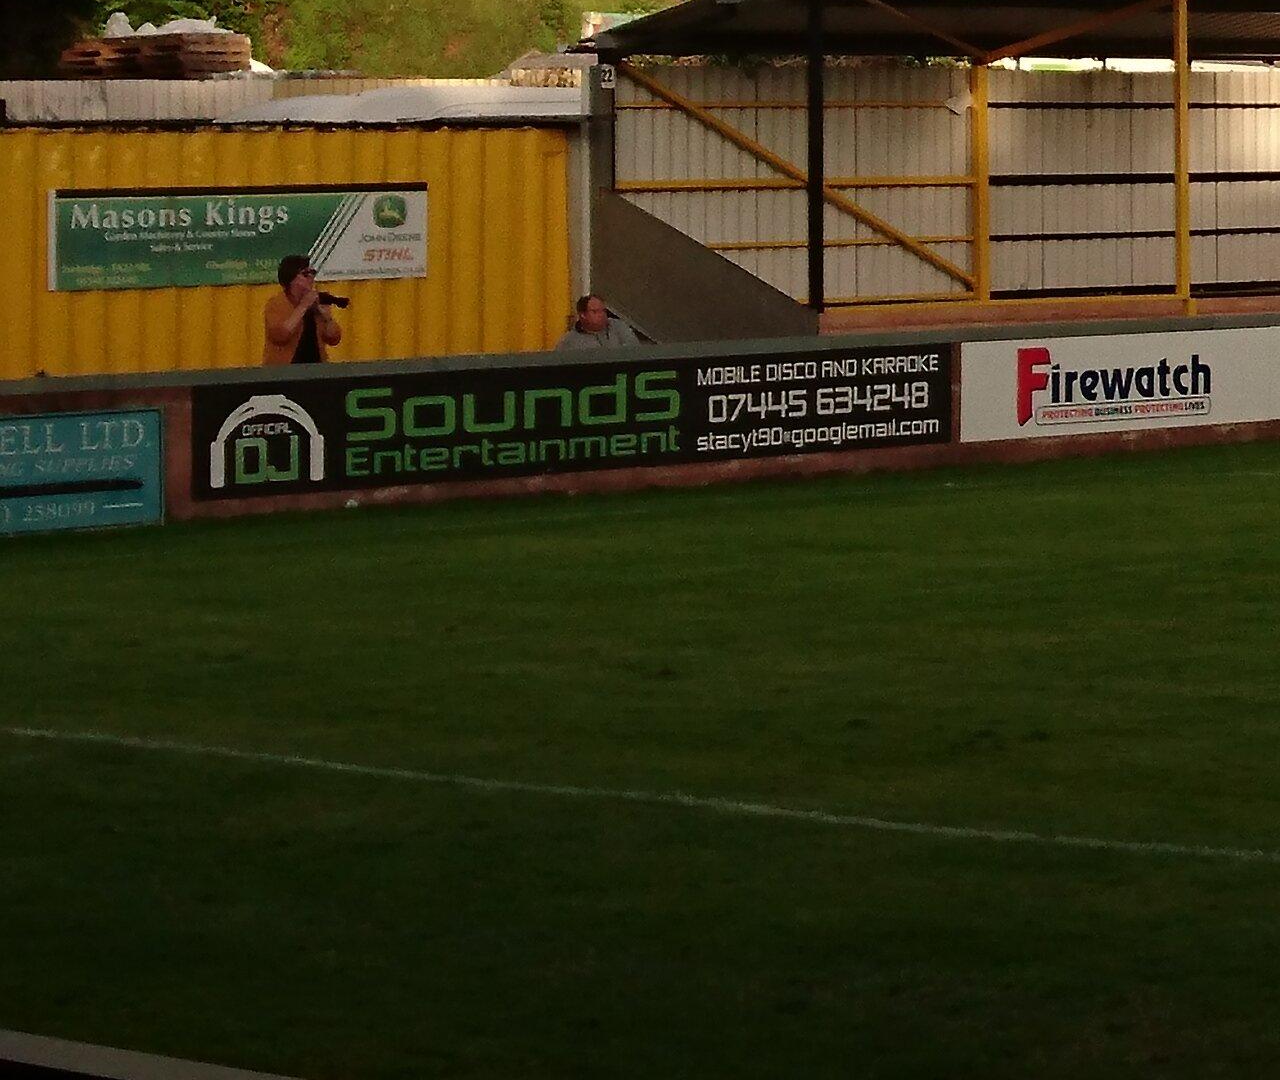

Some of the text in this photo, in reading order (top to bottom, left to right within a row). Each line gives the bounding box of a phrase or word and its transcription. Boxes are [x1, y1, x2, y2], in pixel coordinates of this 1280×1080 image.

[71, 198, 289, 234] Masons Kings
[697, 354, 940, 386] MOBILE DISCO AND KARAOKE
[1016, 347, 1212, 426] Firewatch
[708, 381, 930, 424] 07445 634248
[235, 434, 299, 485] DJ
[345, 424, 681, 478] Entertainment
